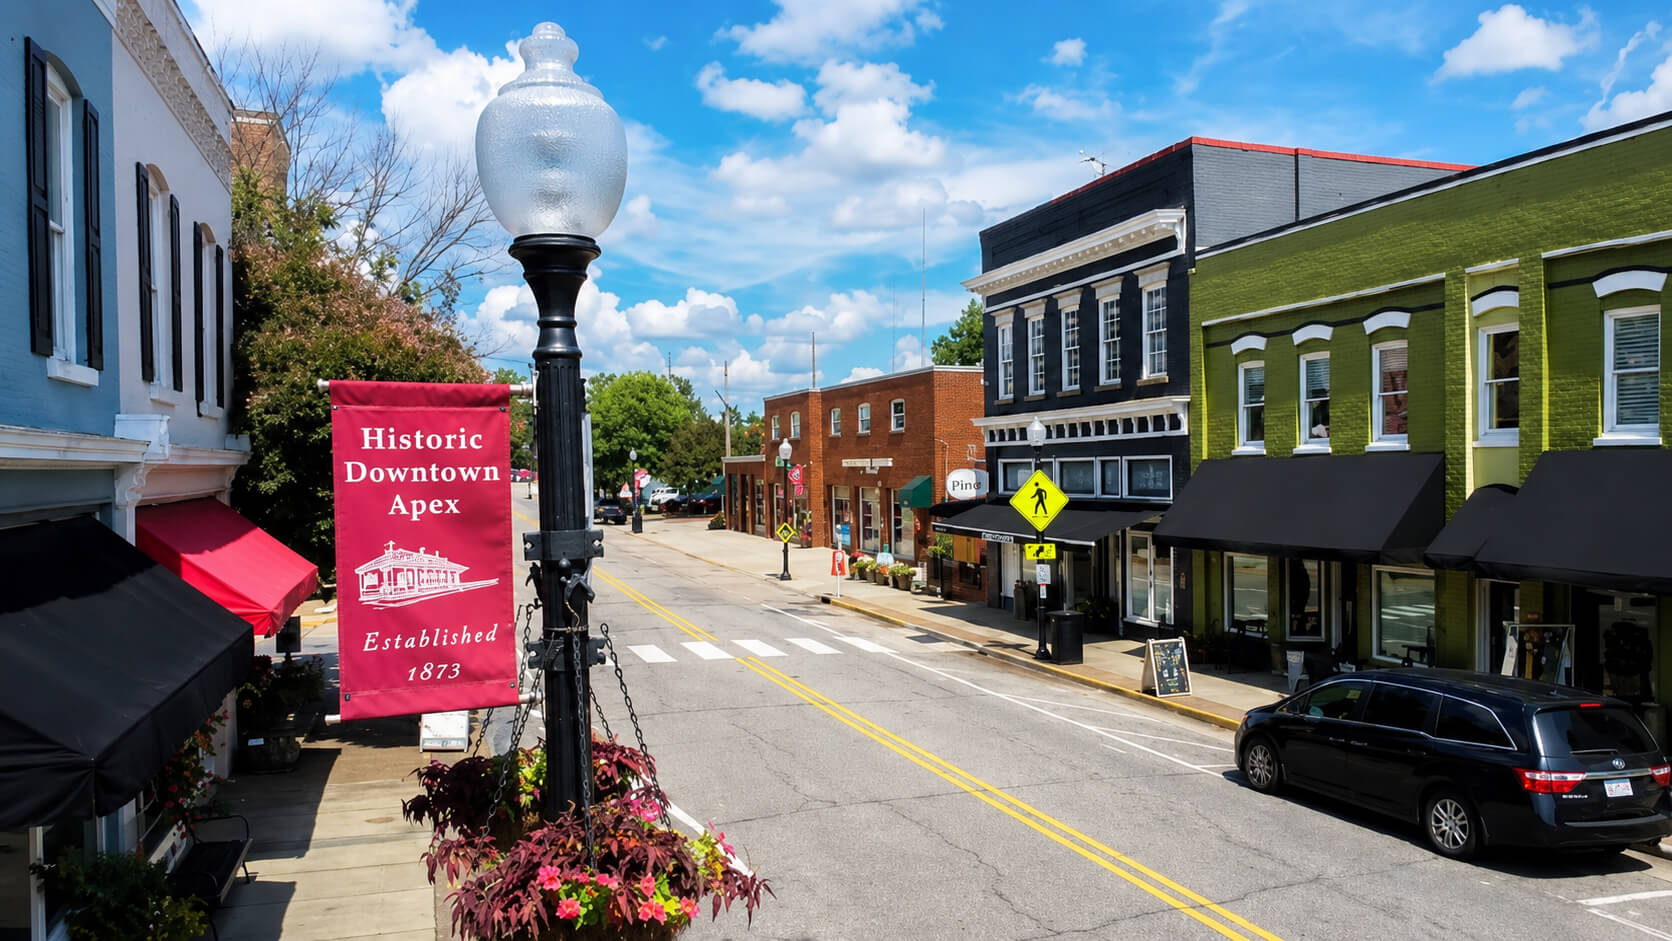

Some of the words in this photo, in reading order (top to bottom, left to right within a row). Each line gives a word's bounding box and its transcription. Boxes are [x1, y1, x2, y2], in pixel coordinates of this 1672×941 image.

[360, 427, 483, 450] Historic
[343, 461, 501, 483] Downtown
[388, 494, 461, 521] Apex
[363, 623, 499, 651] Established
[408, 662, 461, 681] 1873
